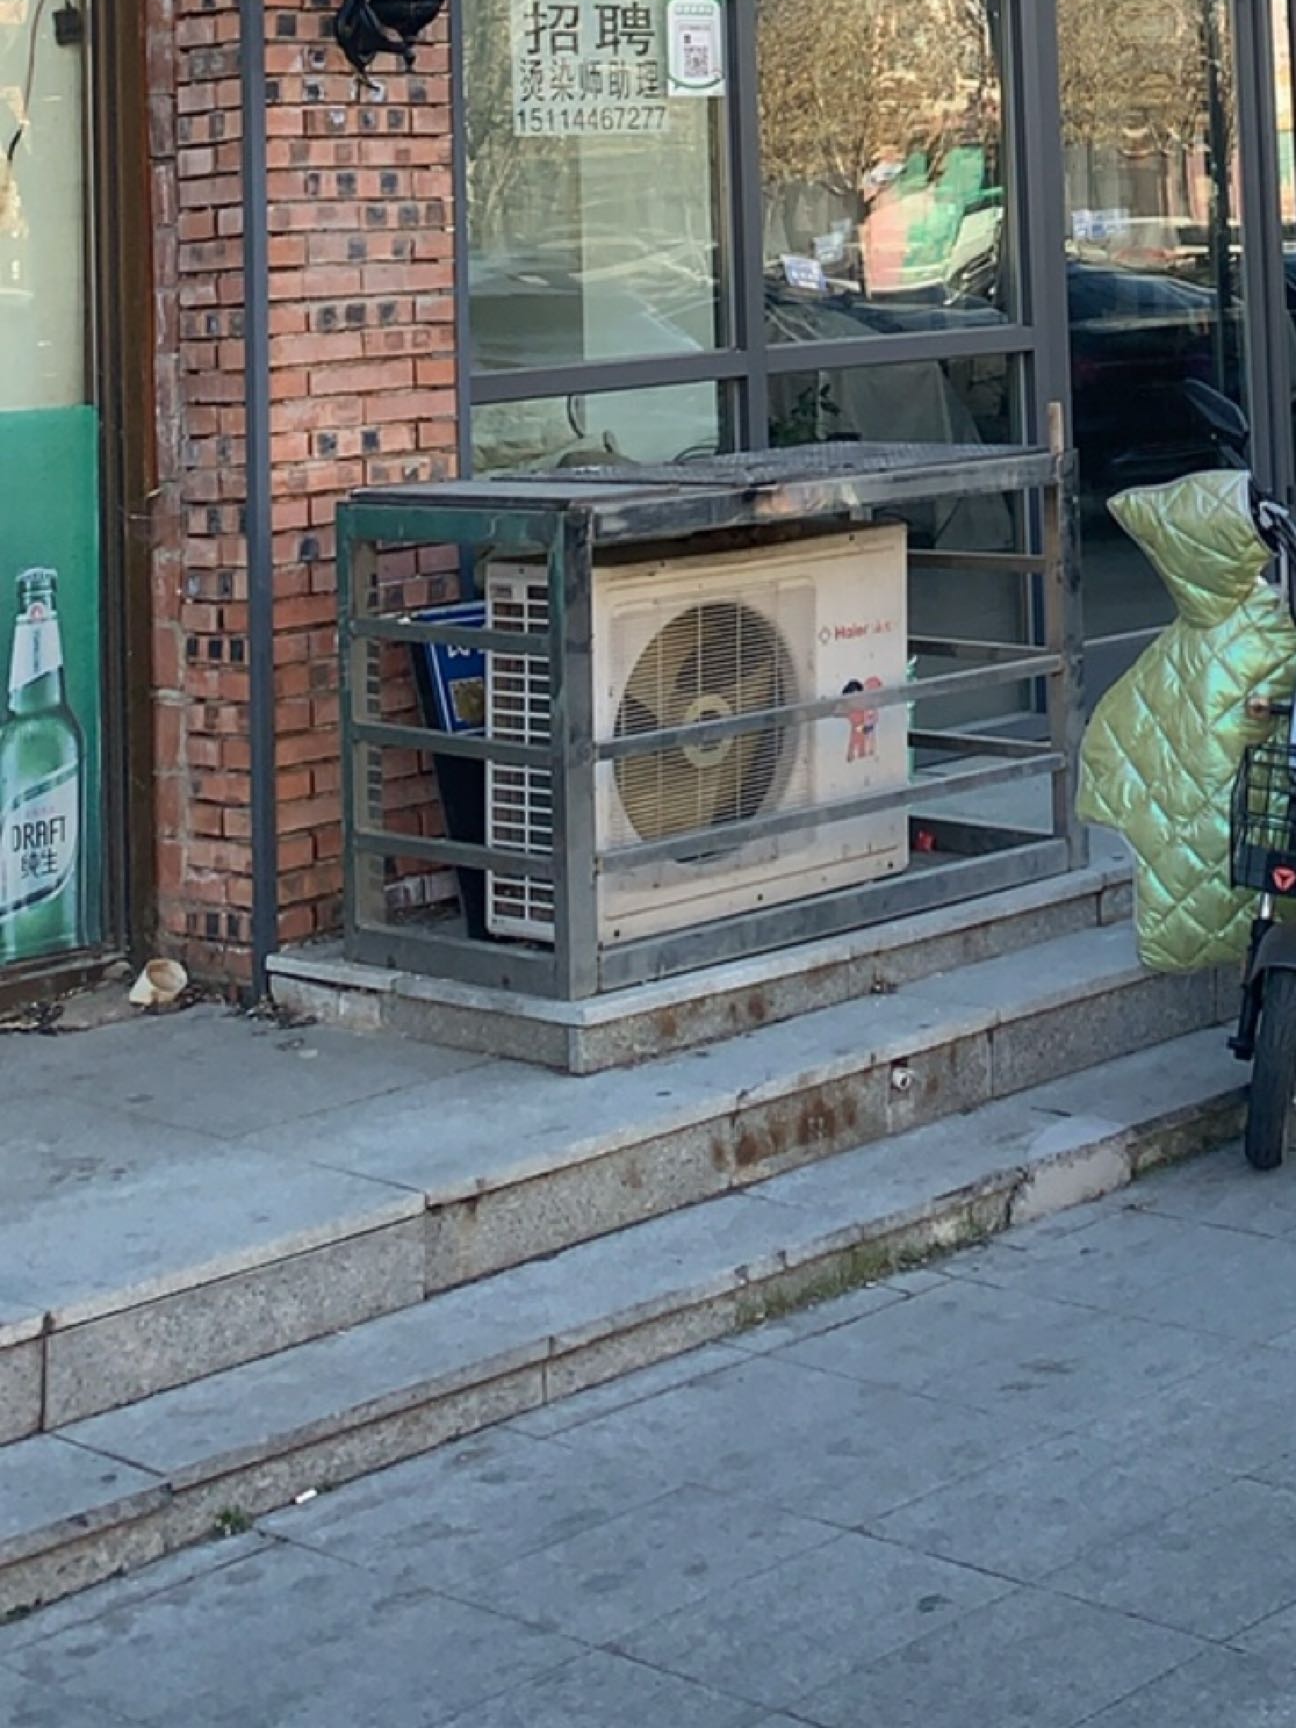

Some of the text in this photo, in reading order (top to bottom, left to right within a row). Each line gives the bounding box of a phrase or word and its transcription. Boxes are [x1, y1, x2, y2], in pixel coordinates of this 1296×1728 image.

[522, 0, 656, 57] 招聘
[518, 57, 661, 103] 烫染师助理
[516, 105, 667, 133] 15114467277
